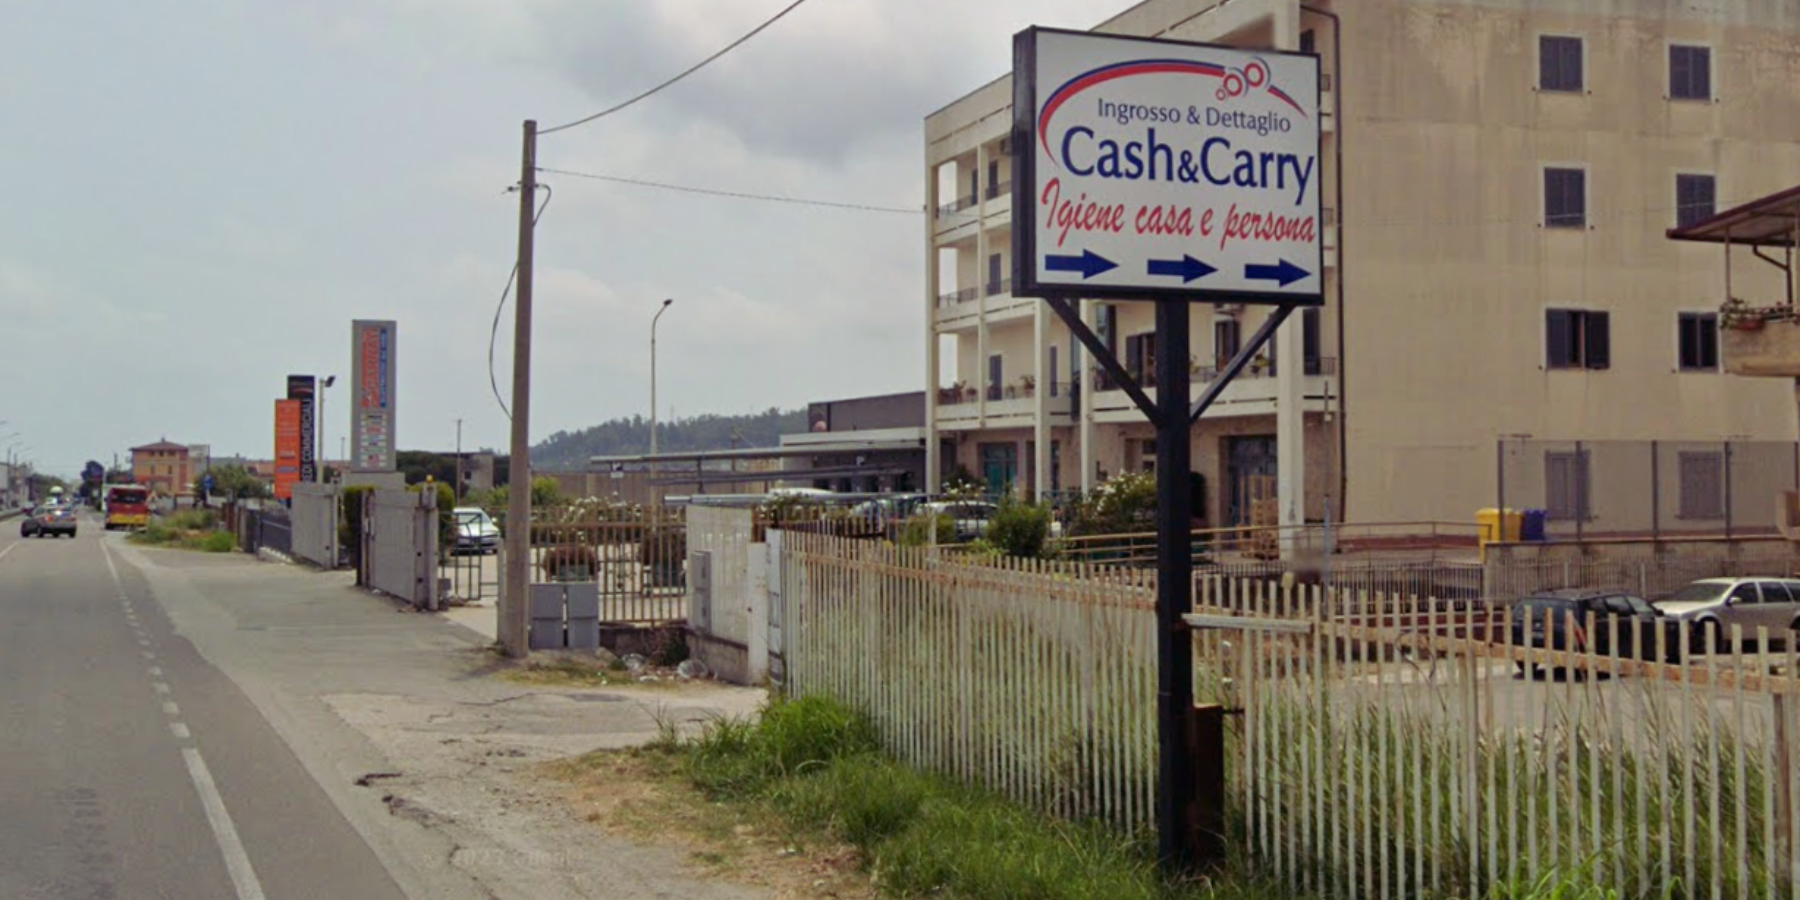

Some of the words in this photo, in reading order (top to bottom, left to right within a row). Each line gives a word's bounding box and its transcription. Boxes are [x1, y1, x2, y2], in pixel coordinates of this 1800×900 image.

[1098, 98, 1181, 125] Ingrosso
[1186, 105, 1201, 124] &
[1206, 106, 1291, 136] Dettaglio
[1061, 125, 1315, 206] Cash&Carry
[1040, 177, 1125, 247] Igiene
[1134, 204, 1193, 237] casa
[1200, 208, 1214, 235] e
[1220, 203, 1316, 251] persona
